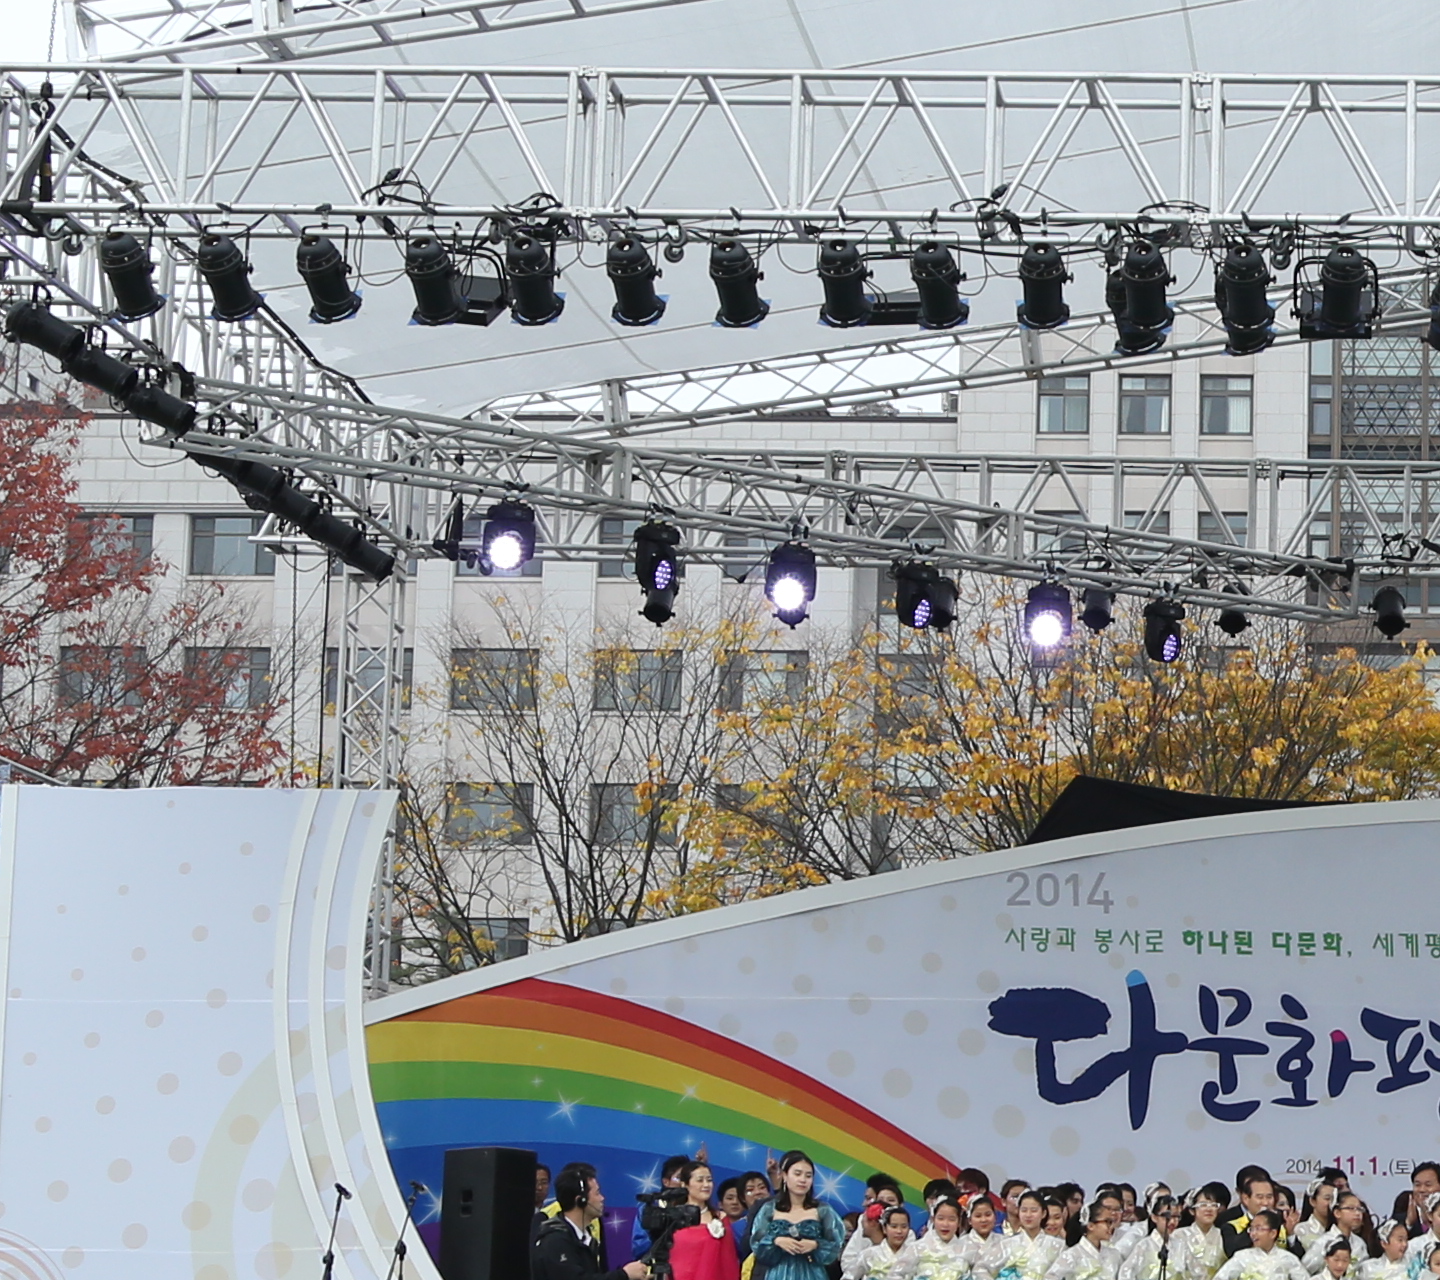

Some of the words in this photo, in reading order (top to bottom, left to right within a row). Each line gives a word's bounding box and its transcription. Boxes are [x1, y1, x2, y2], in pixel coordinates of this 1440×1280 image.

[1005, 871, 1115, 914] 2014
[1004, 926, 1077, 954] 사랑과
[1093, 927, 1165, 956] 봉사로
[1182, 928, 1255, 957] 하나된
[1271, 930, 1354, 959] 다문화,
